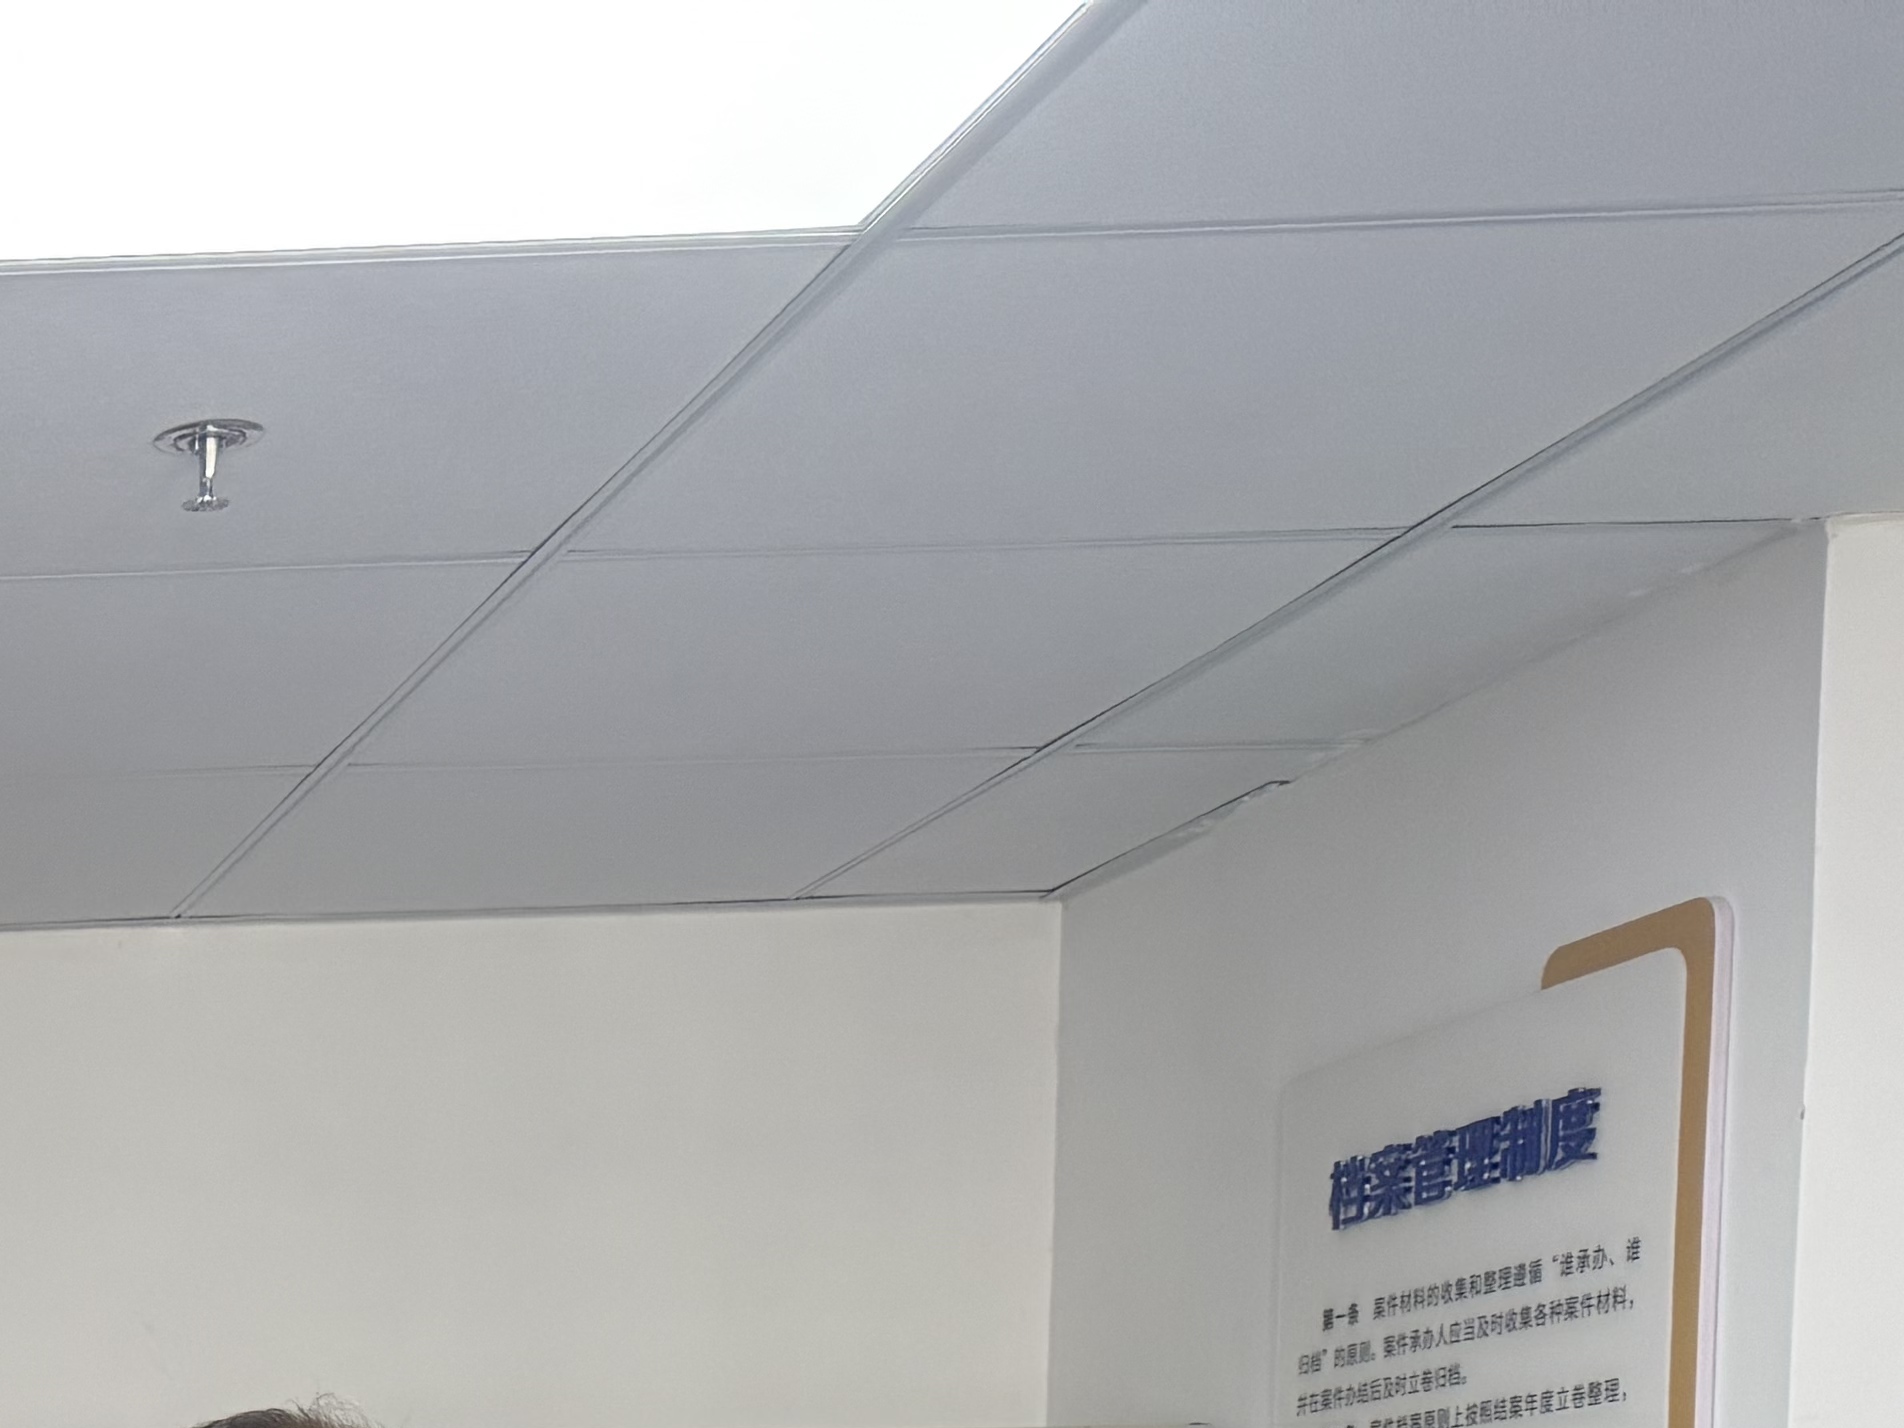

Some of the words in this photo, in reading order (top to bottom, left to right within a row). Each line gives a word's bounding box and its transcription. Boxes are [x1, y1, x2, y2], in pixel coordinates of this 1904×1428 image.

[1329, 1087, 1601, 1230] 档案管理制度
